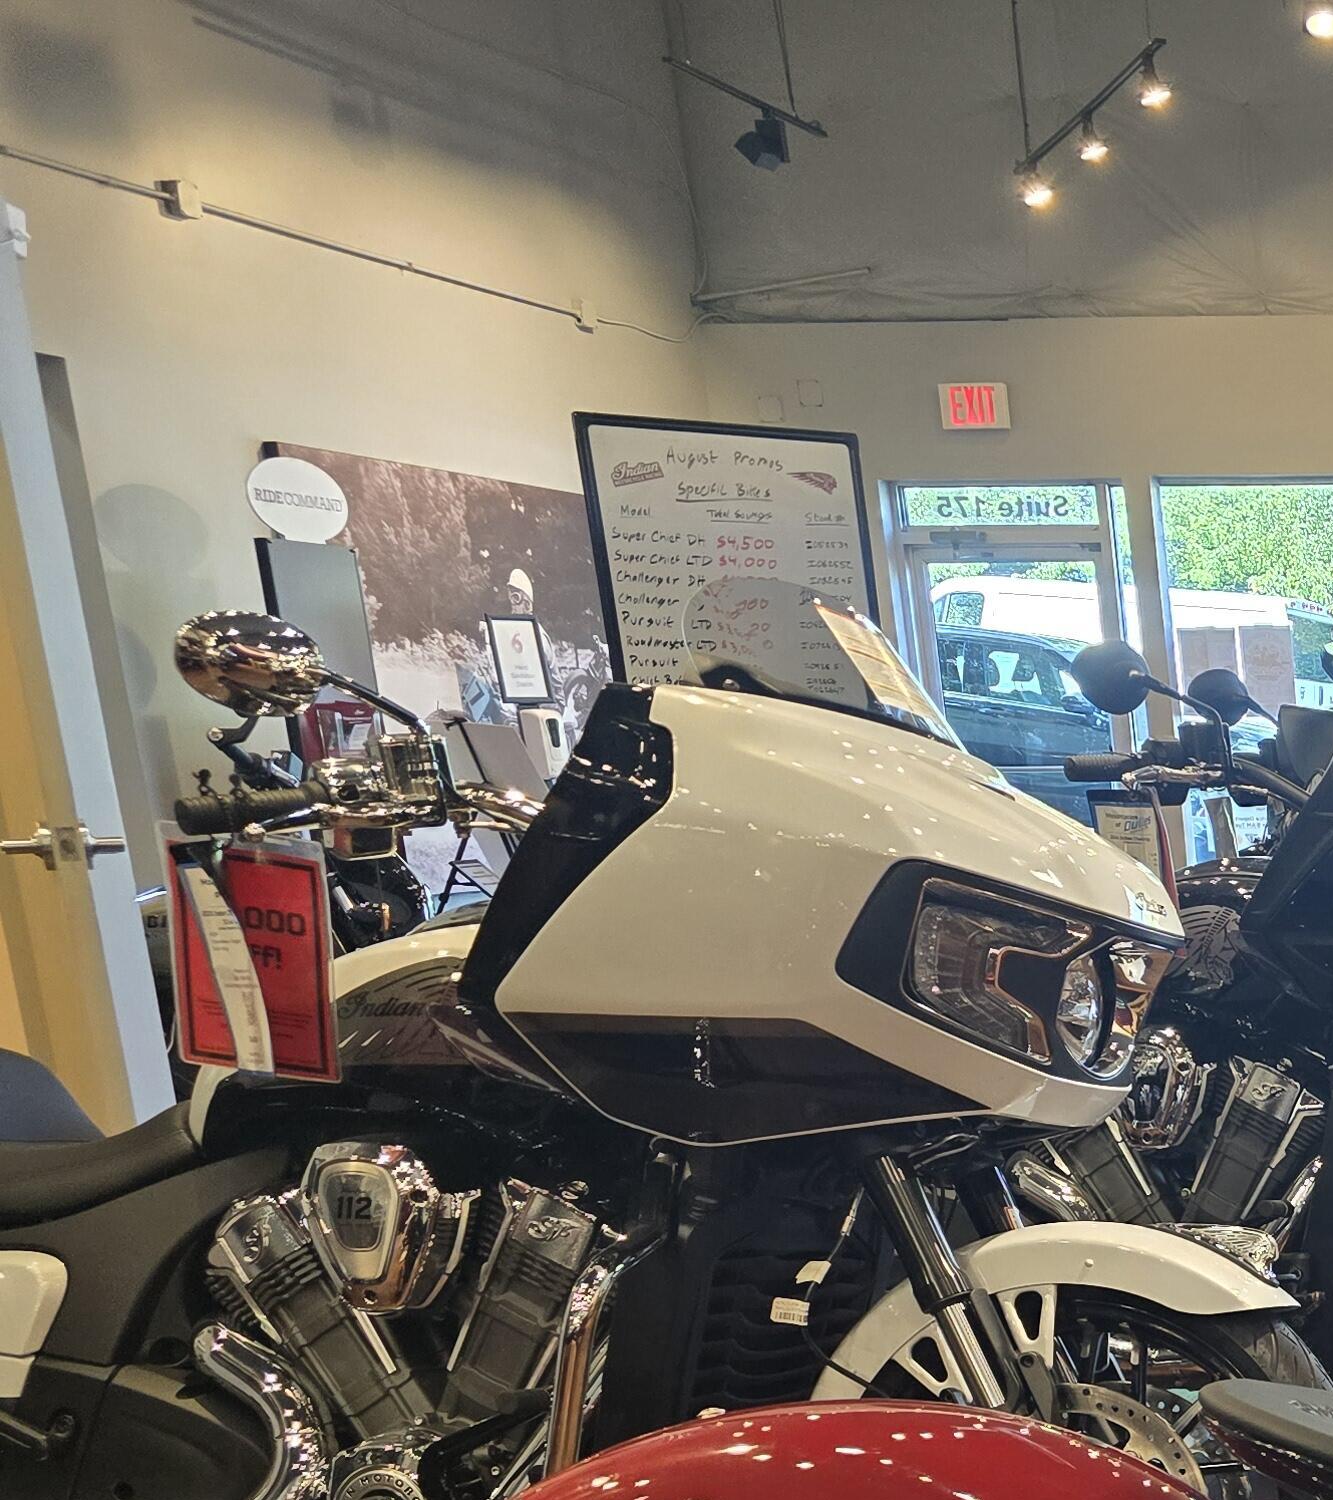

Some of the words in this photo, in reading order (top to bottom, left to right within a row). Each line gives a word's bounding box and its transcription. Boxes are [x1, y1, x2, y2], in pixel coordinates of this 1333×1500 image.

[949, 386, 996, 425] EXIT
[666, 446, 718, 469] August
[611, 526, 646, 543] Super
[717, 535, 775, 551] $4,500
[614, 550, 648, 566] Super
[719, 556, 778, 570] $4,000
[617, 570, 680, 587] Challenger
[618, 592, 680, 608] Challenger
[621, 611, 674, 628] Pursuit
[629, 655, 679, 667] Pursuit
[250, 945, 282, 969] FF!
[339, 992, 426, 1018] Indian
[337, 1196, 372, 1219] 112
